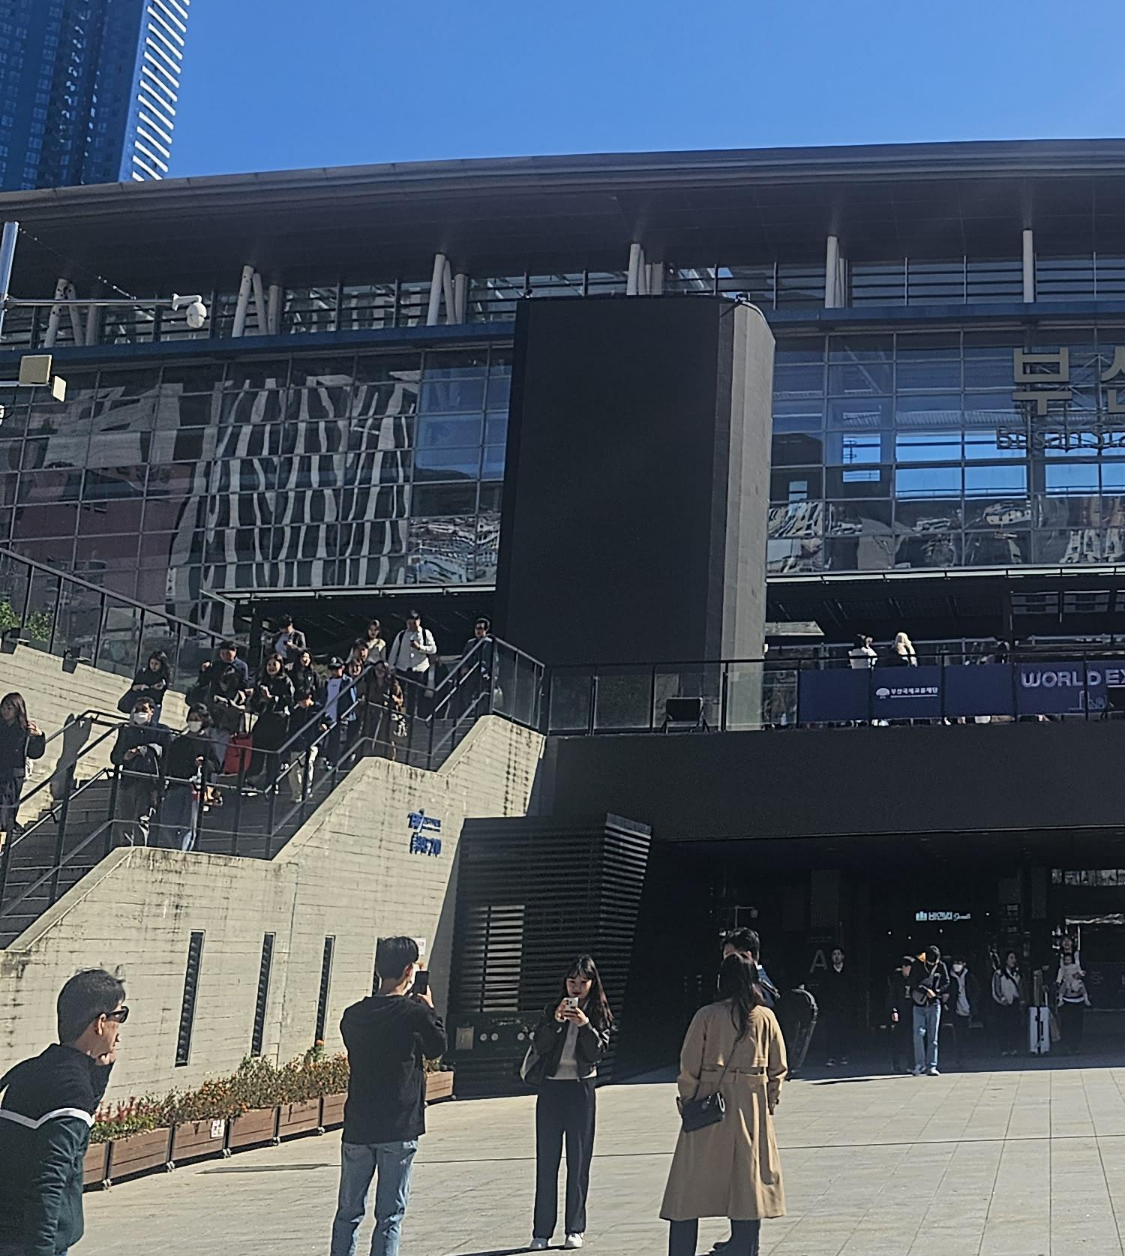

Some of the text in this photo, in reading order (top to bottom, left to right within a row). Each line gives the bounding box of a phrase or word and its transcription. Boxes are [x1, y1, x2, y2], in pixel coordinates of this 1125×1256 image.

[997, 424, 1082, 449] Busan
[1021, 670, 1101, 688] WORLD
[809, 948, 828, 974] A
